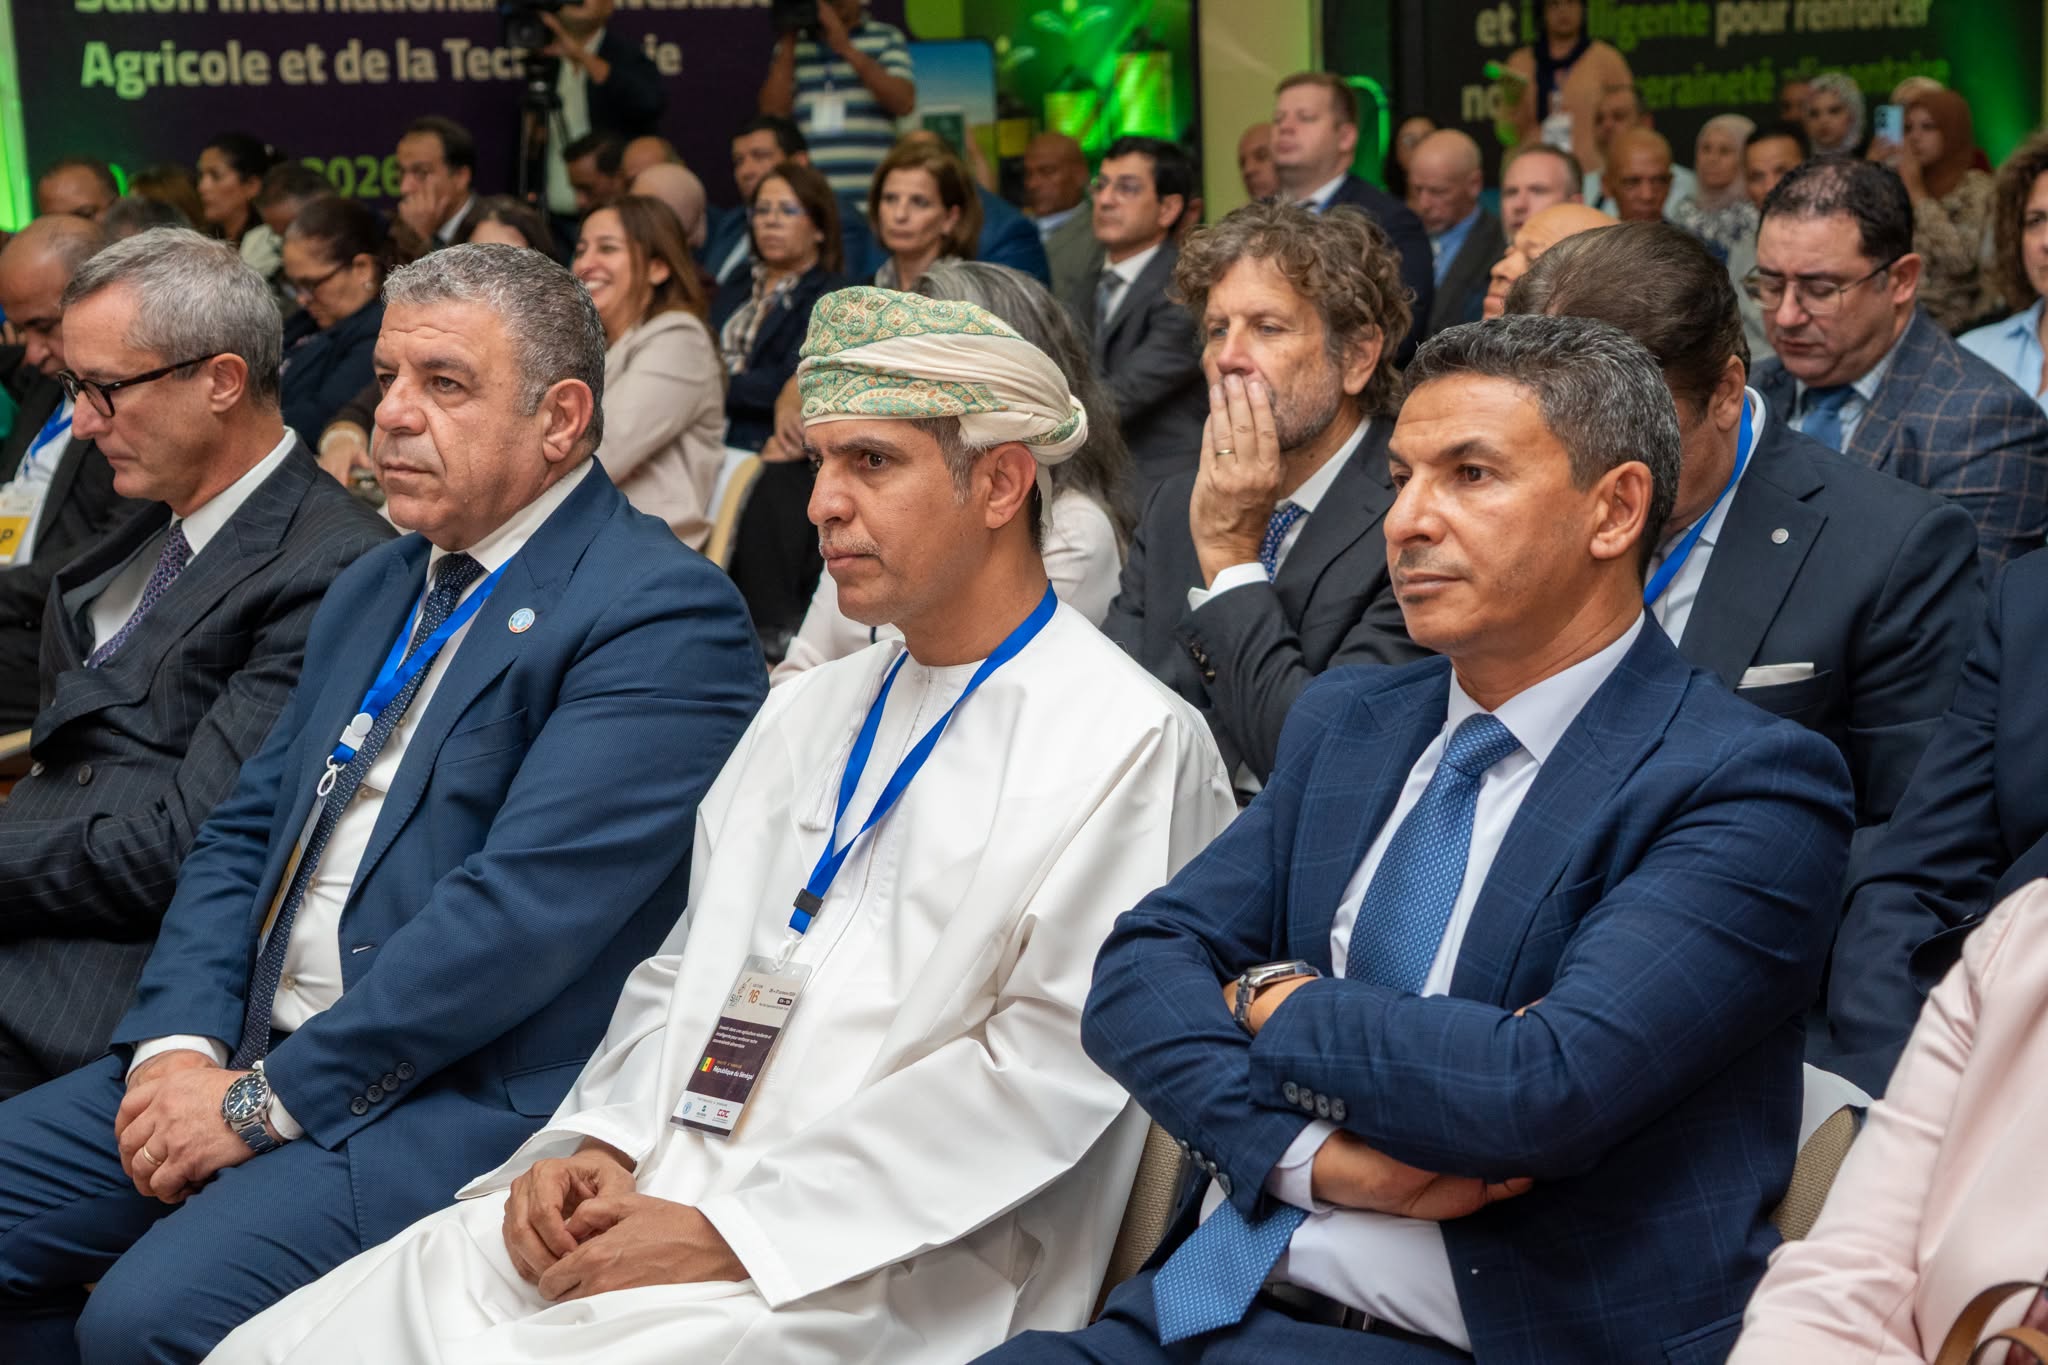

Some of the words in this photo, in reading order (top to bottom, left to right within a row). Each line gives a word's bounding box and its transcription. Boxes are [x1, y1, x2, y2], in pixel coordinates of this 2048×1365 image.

[1476, 3, 1515, 46] et
[1715, 0, 1790, 47] pour
[81, 40, 271, 99] Agricole
[279, 43, 327, 85] et
[334, 38, 391, 84] de
[396, 38, 438, 83] la
[747, 989, 760, 1004] 16
